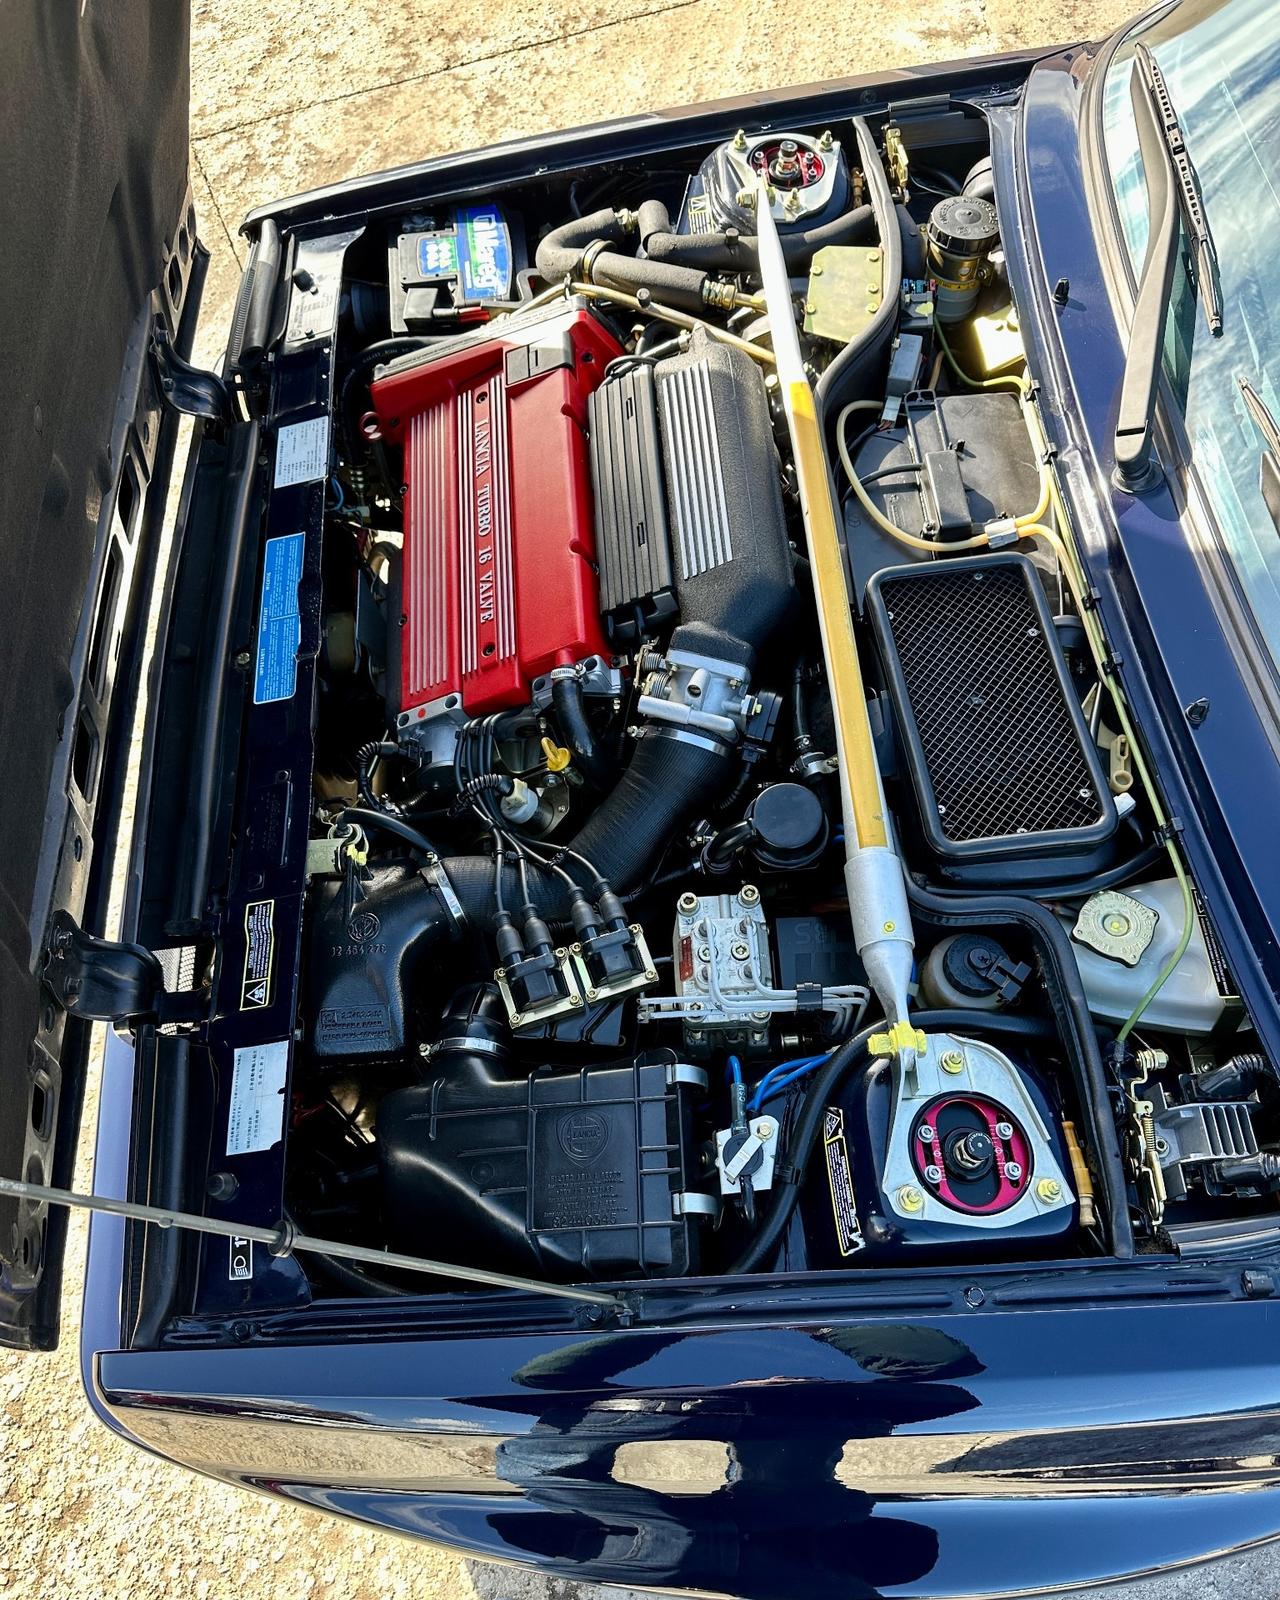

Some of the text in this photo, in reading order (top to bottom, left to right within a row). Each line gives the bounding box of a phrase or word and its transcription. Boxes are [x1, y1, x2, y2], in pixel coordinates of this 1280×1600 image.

[473, 230, 504, 295] Mareg
[475, 417, 494, 624] LANCIA TURBO 16 VALVE
